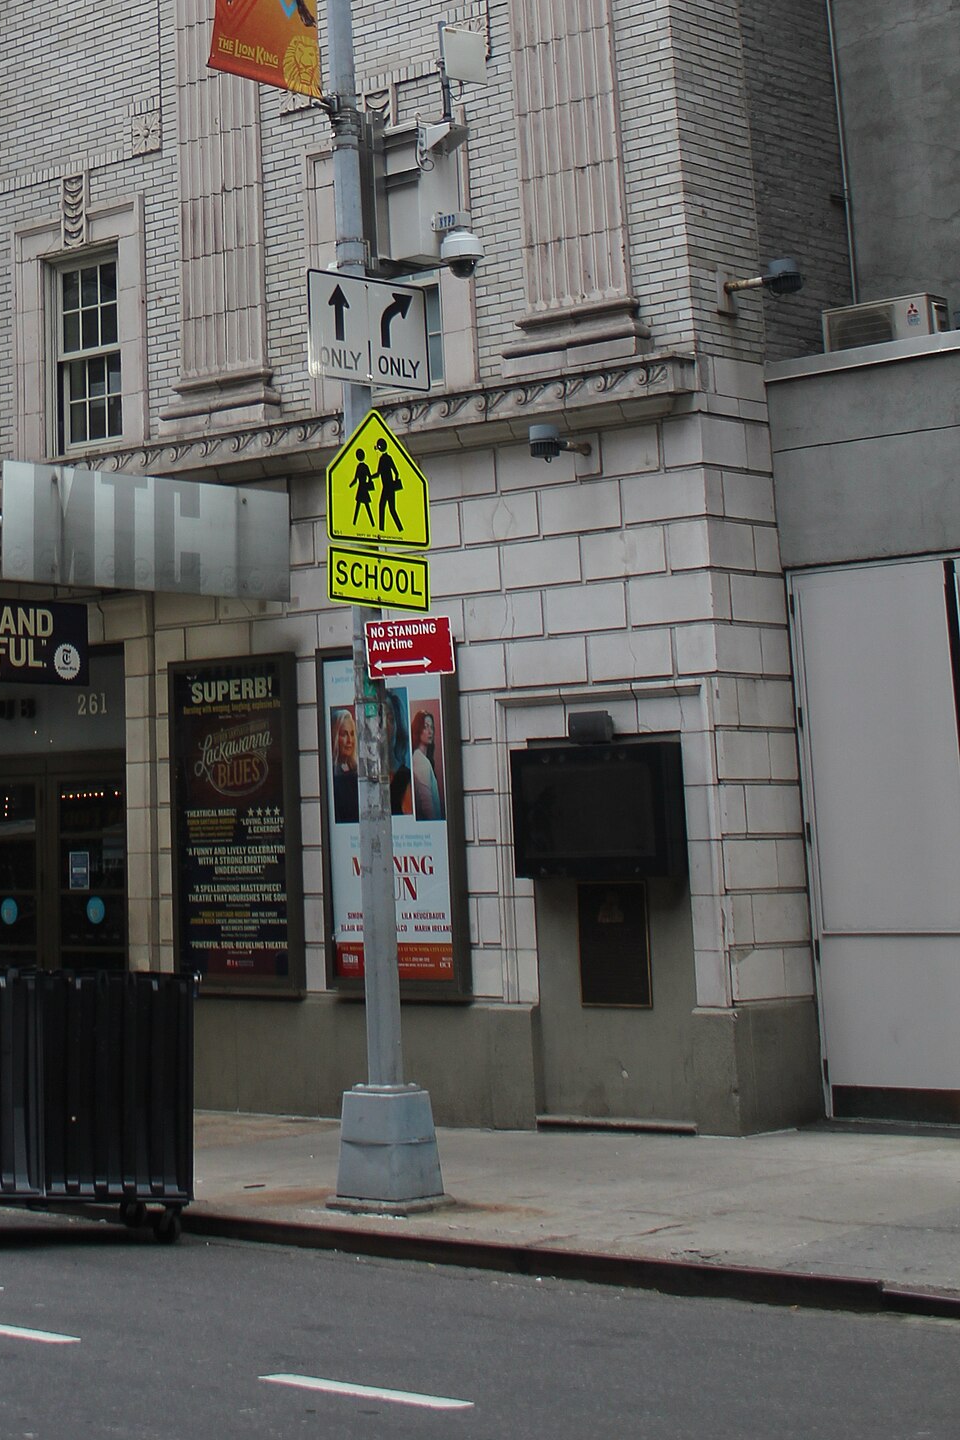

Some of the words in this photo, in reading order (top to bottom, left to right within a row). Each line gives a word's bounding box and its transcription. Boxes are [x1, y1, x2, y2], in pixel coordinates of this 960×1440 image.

[218, 37, 235, 51] THE
[320, 346, 362, 371] ONLY
[378, 355, 420, 379] ONLY
[33, 462, 200, 592] MTC
[336, 560, 423, 596] SCHOOL
[0, 606, 54, 638] AND
[370, 627, 385, 638] NO
[387, 623, 436, 638] STANDING
[372, 638, 414, 653] Anytime
[78, 693, 107, 715] 261
[217, 757, 261, 790] BLUES
[214, 847, 226, 855] AND
[227, 846, 246, 855] LIVELY
[198, 856, 214, 865] WITH
[220, 856, 243, 864] STRONG
[244, 855, 279, 864] EMOTIONAL
[200, 883, 240, 893] SPELLBINDING
[188, 893, 213, 902] THEATRE
[214, 893, 227, 902] THAT
[228, 893, 260, 902] NOURISHES
[261, 893, 273, 902] THE
[347, 912, 363, 920] SIMON
[401, 912, 412, 920] LILA
[413, 912, 445, 920] NEUGEBAUER
